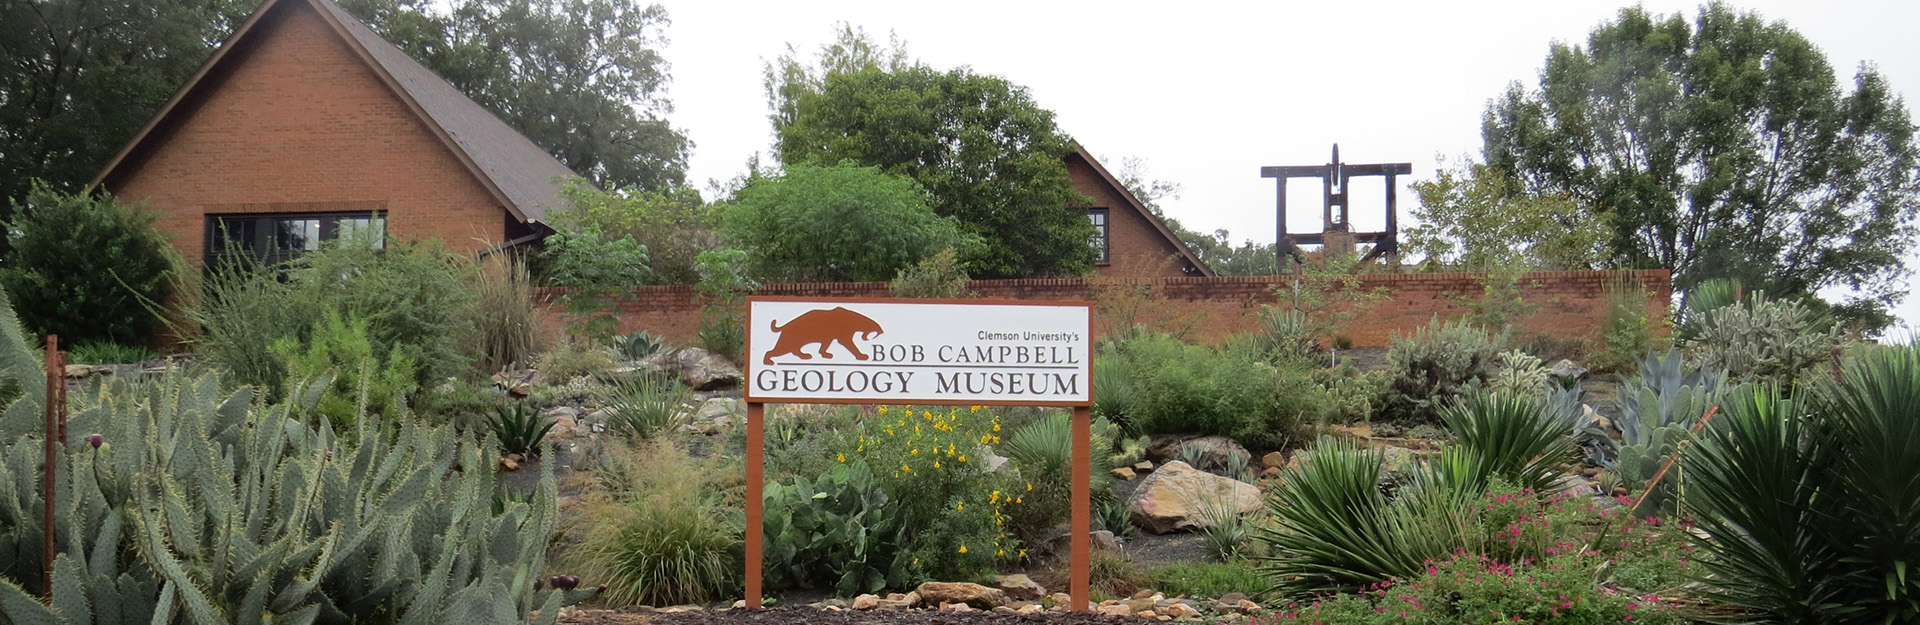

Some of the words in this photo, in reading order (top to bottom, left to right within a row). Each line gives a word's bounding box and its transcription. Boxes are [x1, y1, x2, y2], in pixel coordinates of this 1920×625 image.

[977, 330, 1019, 341] Clemson
[1023, 330, 1079, 343] University's
[871, 344, 925, 362] BOB
[938, 345, 1079, 364] CAMPBELL
[757, 369, 915, 393] GEOLOGY
[935, 371, 1079, 395] MUSEUM
